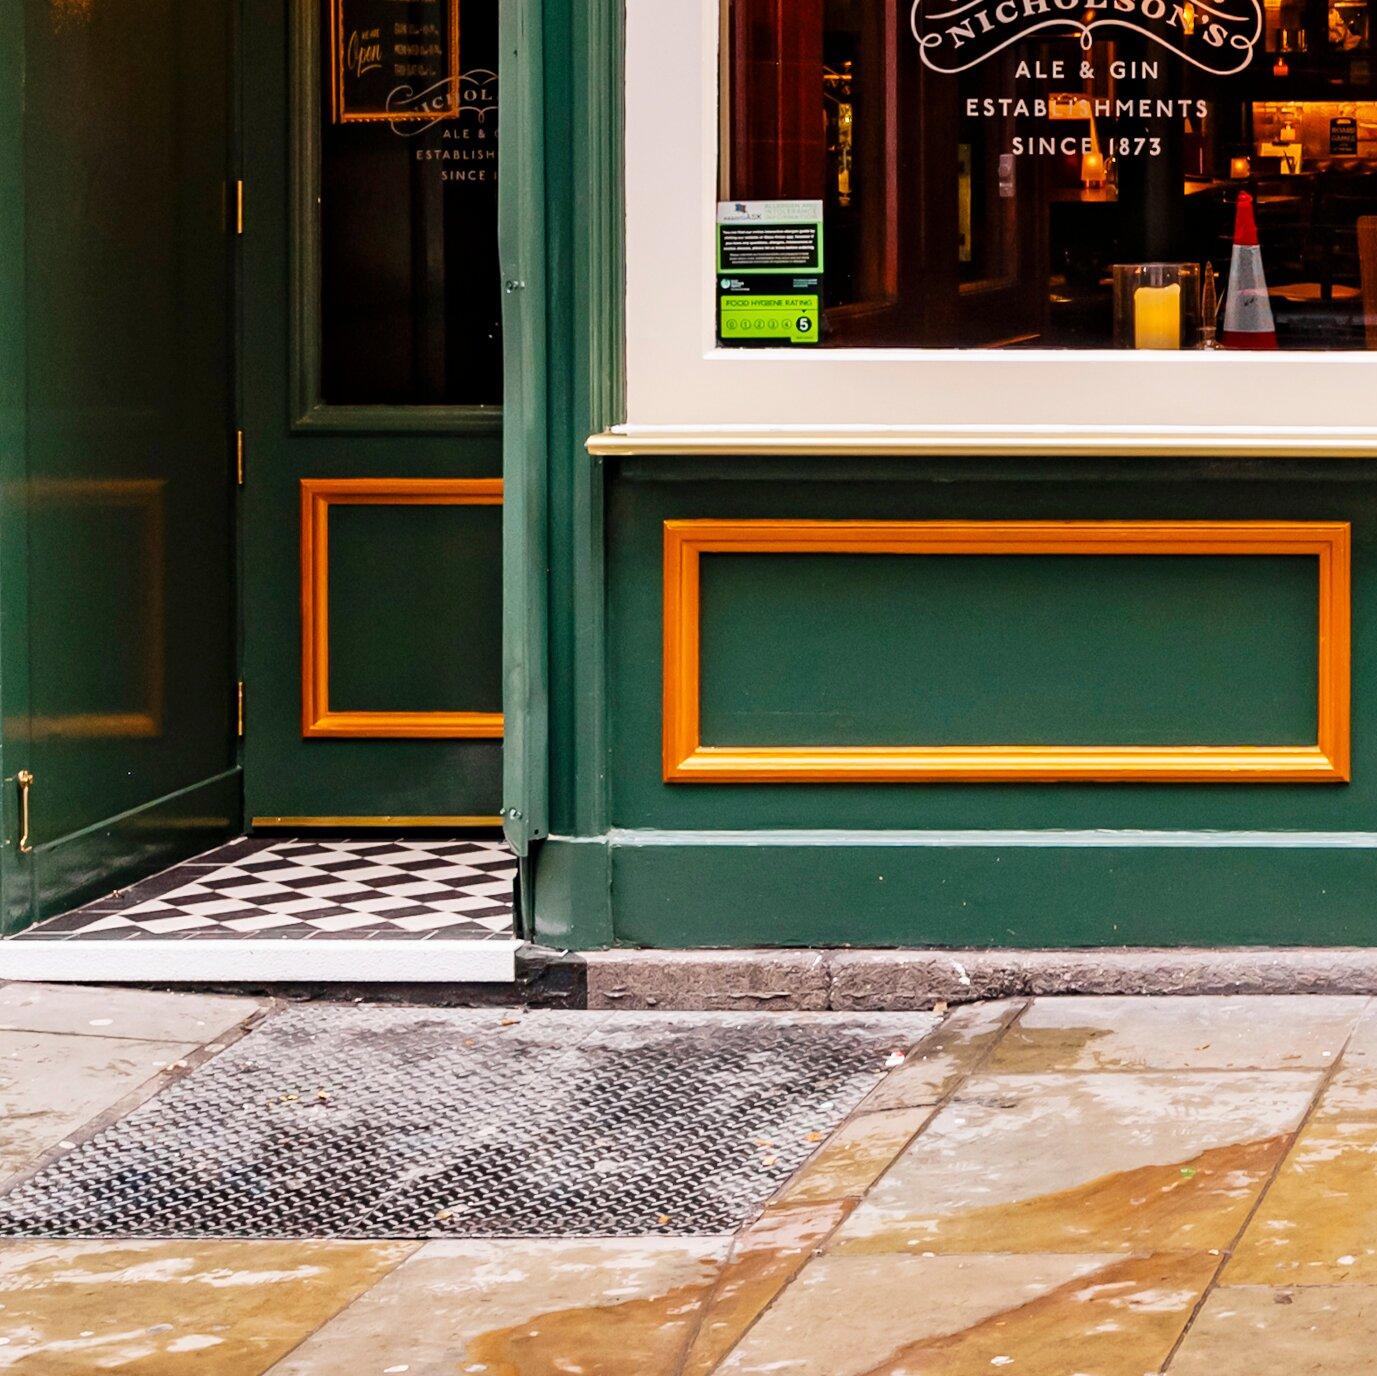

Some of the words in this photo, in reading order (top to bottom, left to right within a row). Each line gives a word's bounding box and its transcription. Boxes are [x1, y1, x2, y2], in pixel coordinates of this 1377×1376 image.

[347, 30, 382, 78] Open
[1015, 61, 1065, 79] ALE
[1079, 61, 1095, 79] &
[1110, 61, 1158, 79] GIN
[966, 98, 1208, 118] ESTABLISHMENTS
[443, 129, 470, 139] ALE
[478, 129, 486, 139] &
[1012, 137, 1091, 155] SINCE
[1109, 137, 1162, 155] 1873
[416, 150, 495, 160] ESTABLISH
[440, 170, 486, 180] SINCE
[726, 299, 749, 307] FOOD
[751, 299, 784, 307] HYGIENE
[799, 318, 809, 331] 5
